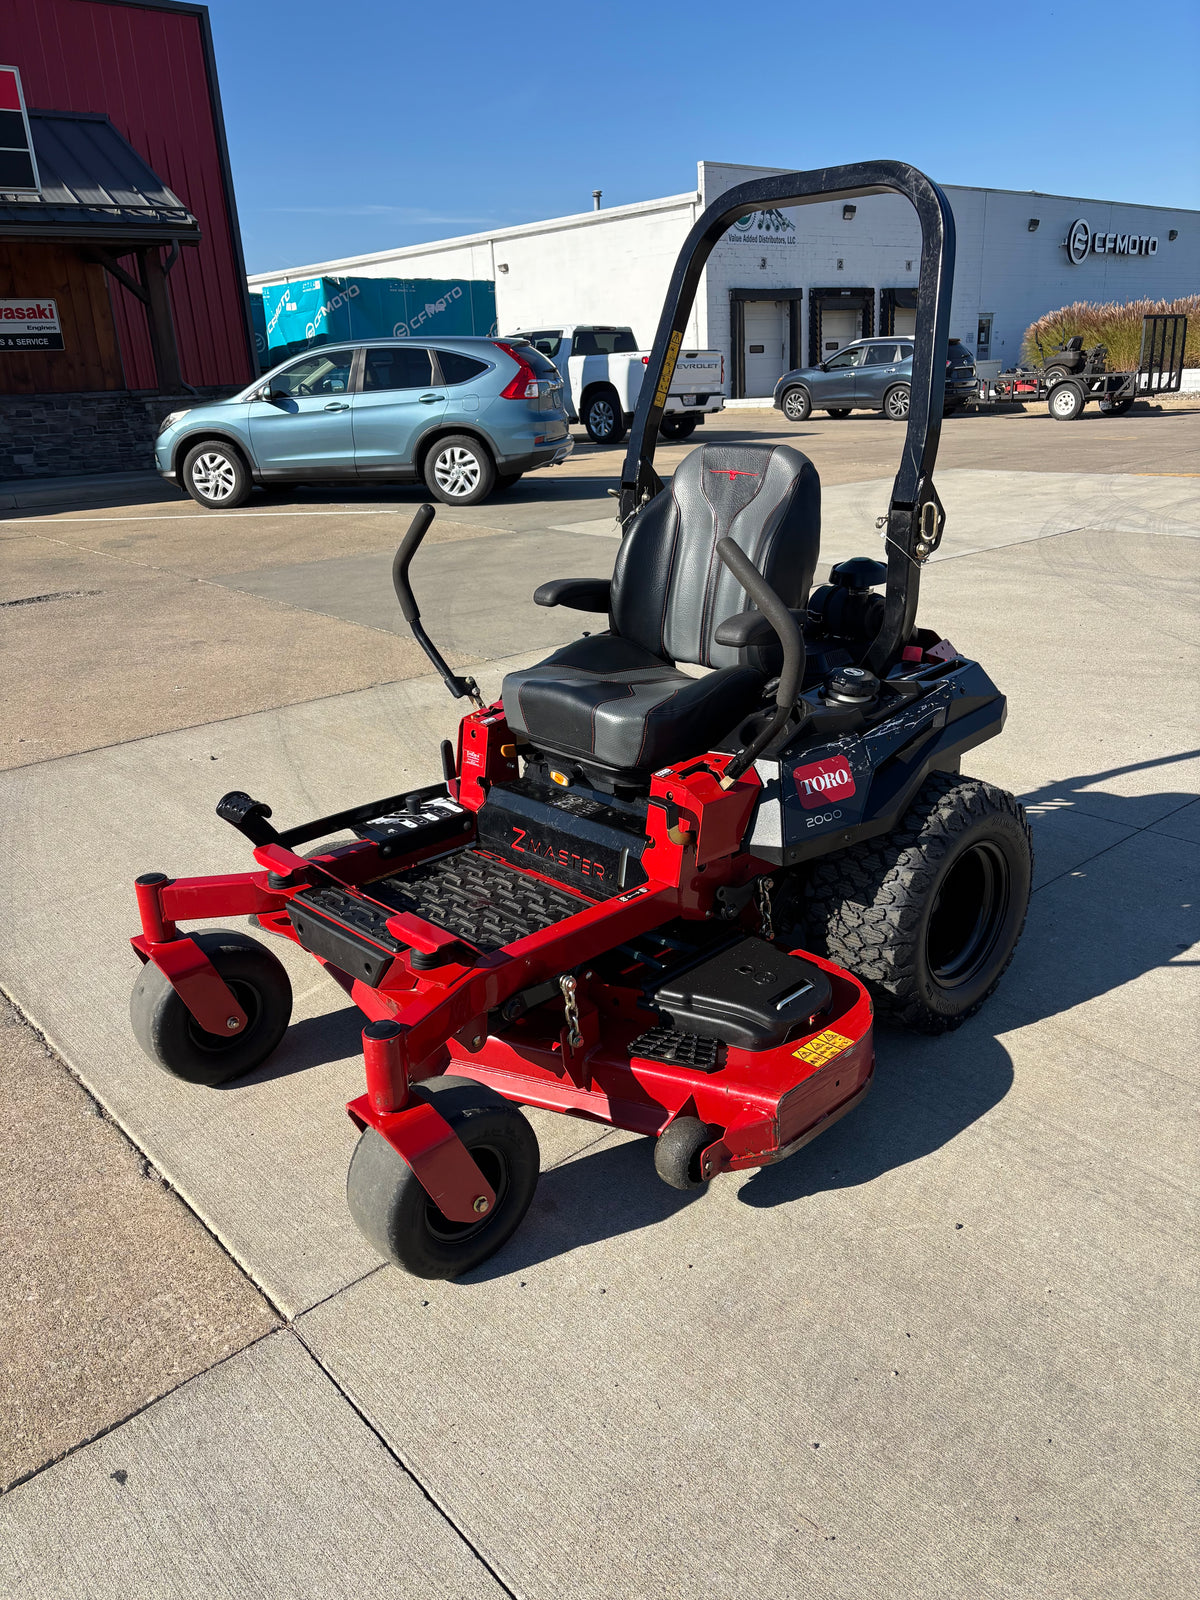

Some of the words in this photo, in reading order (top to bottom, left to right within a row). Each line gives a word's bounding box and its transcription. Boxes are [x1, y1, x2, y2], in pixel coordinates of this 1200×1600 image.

[728, 233, 742, 243] Value
[743, 234, 758, 243] Added
[759, 235, 786, 245] Distributors,
[787, 236, 796, 245] LLC
[1093, 233, 1159, 255] CFMOTO
[0, 304, 55, 320] asaki
[27, 324, 57, 332] Engines
[16, 338, 50, 346] SERVICE
[800, 769, 849, 796] TORO
[805, 809, 843, 828] 2000
